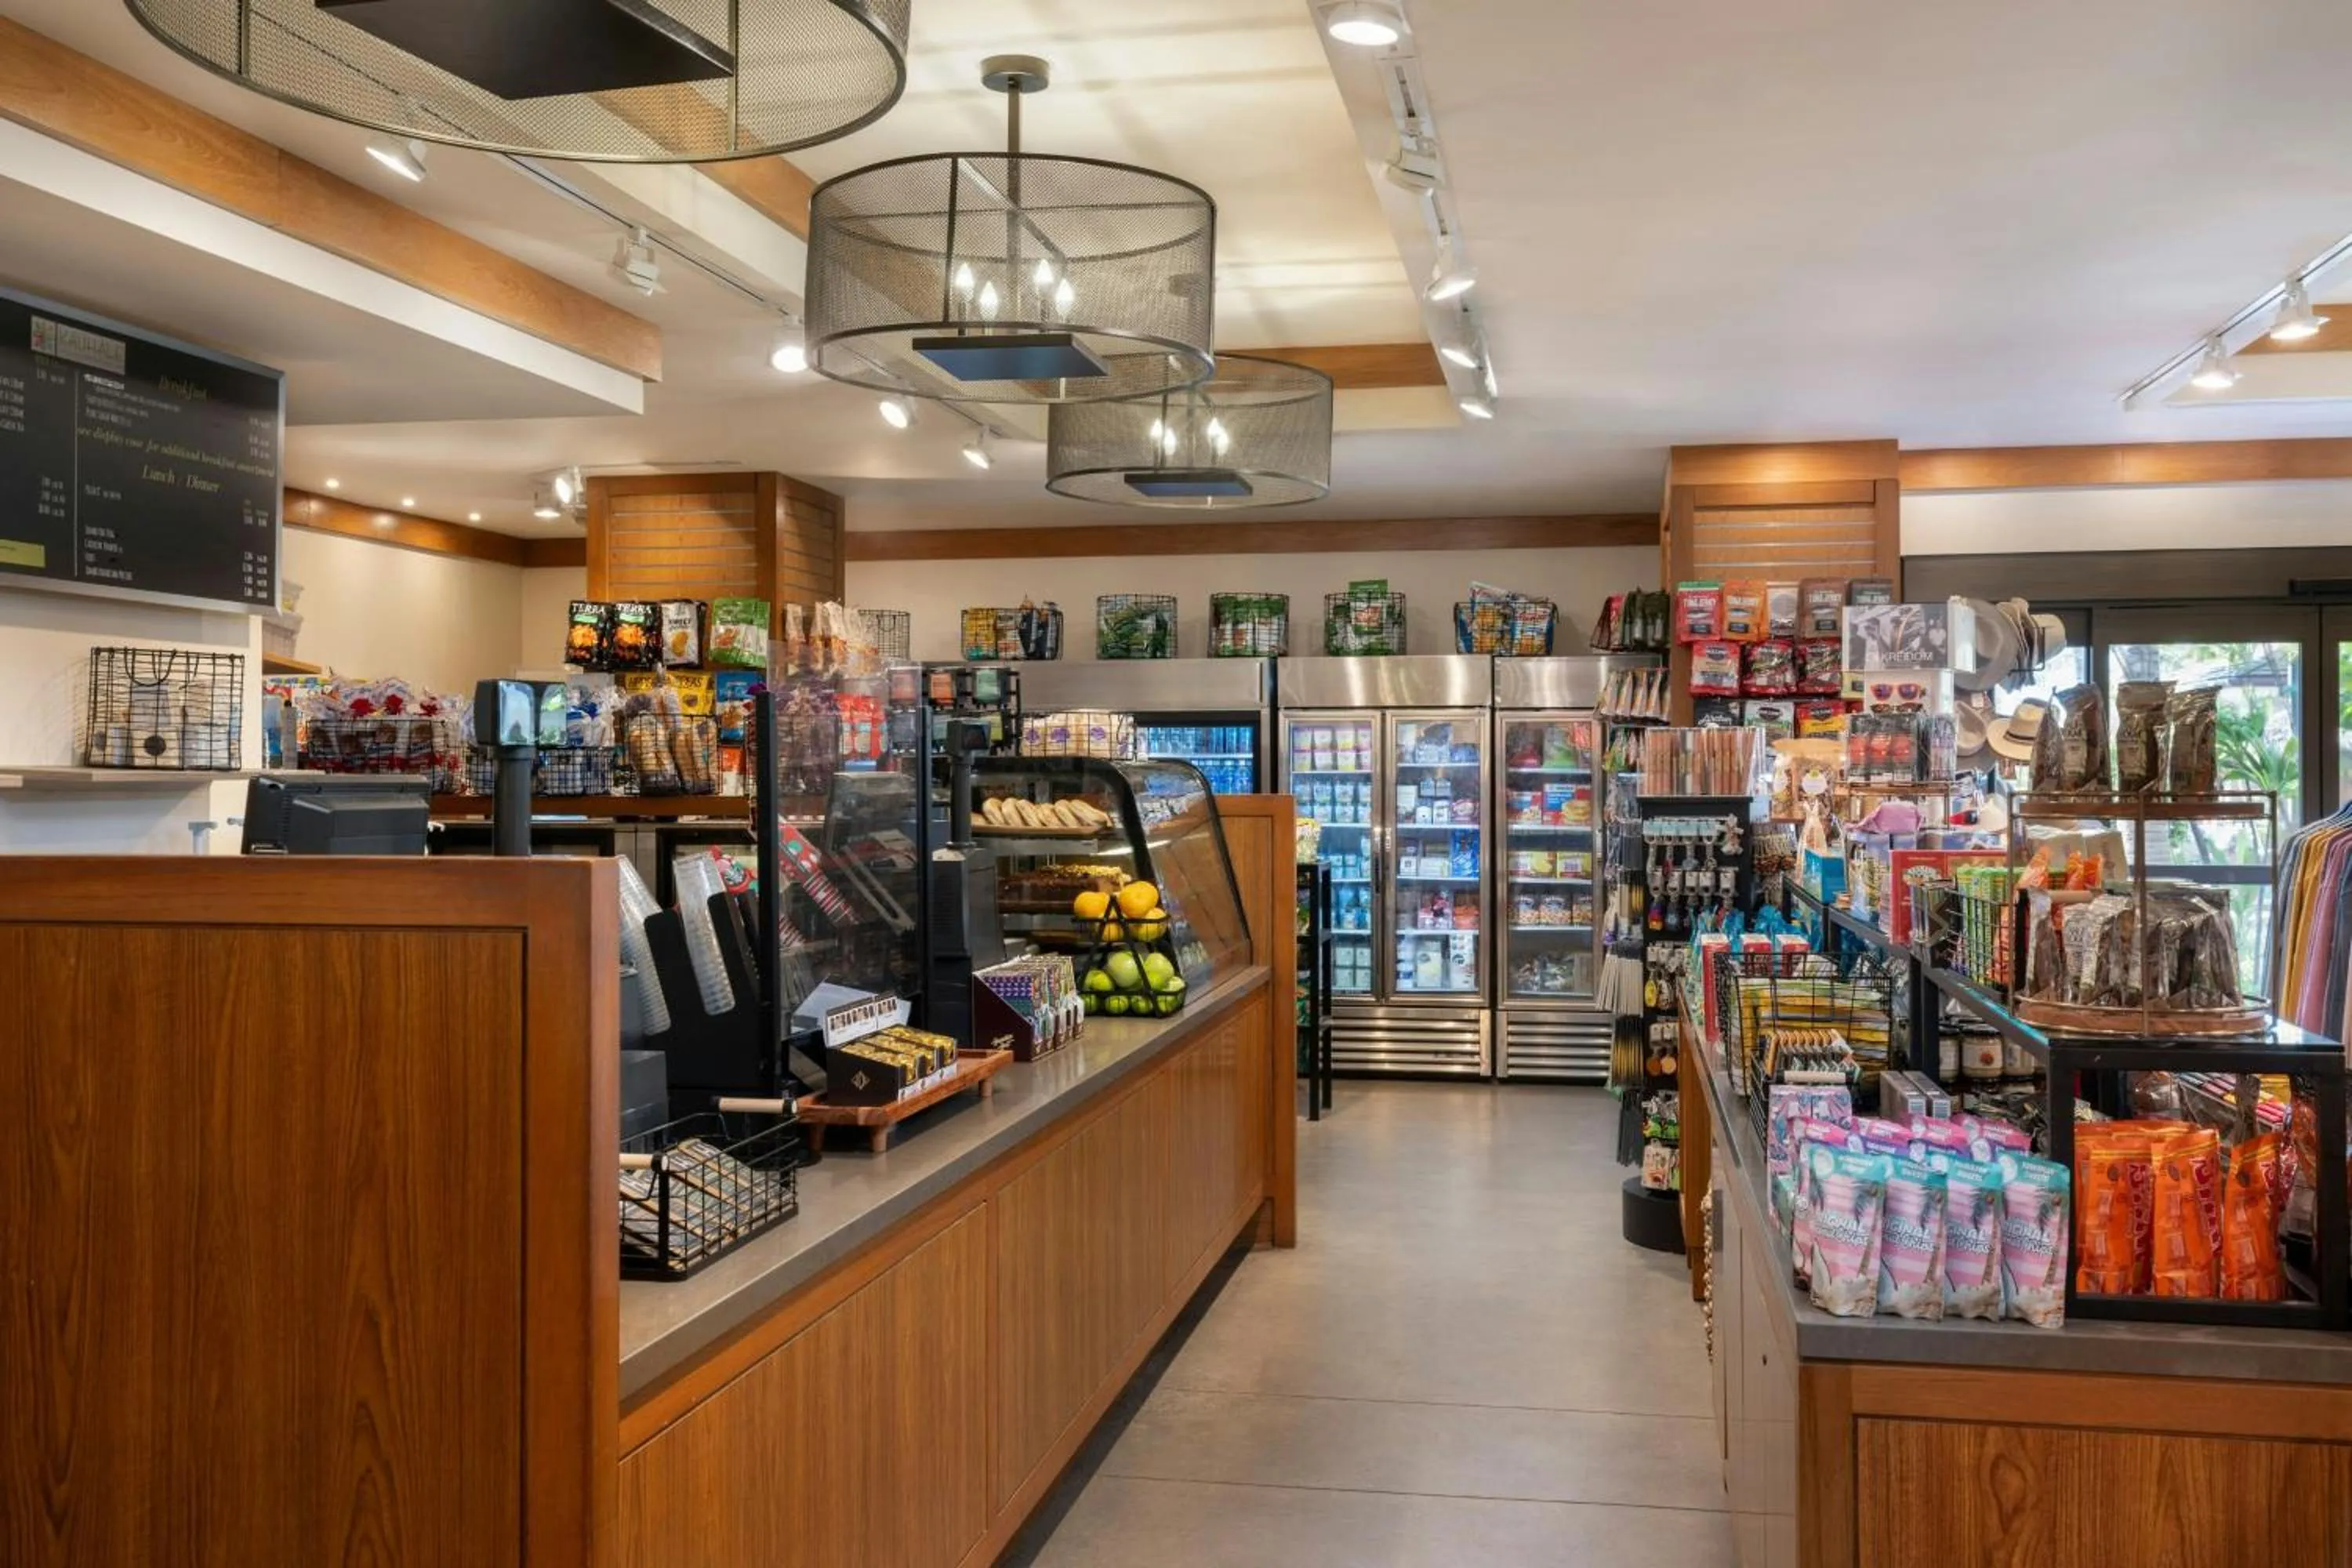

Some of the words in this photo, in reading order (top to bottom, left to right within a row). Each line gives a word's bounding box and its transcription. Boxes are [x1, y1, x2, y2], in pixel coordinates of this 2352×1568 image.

[142, 464, 176, 485] Lunch
[572, 603, 605, 614] TERRA
[615, 603, 652, 614] TERRA
